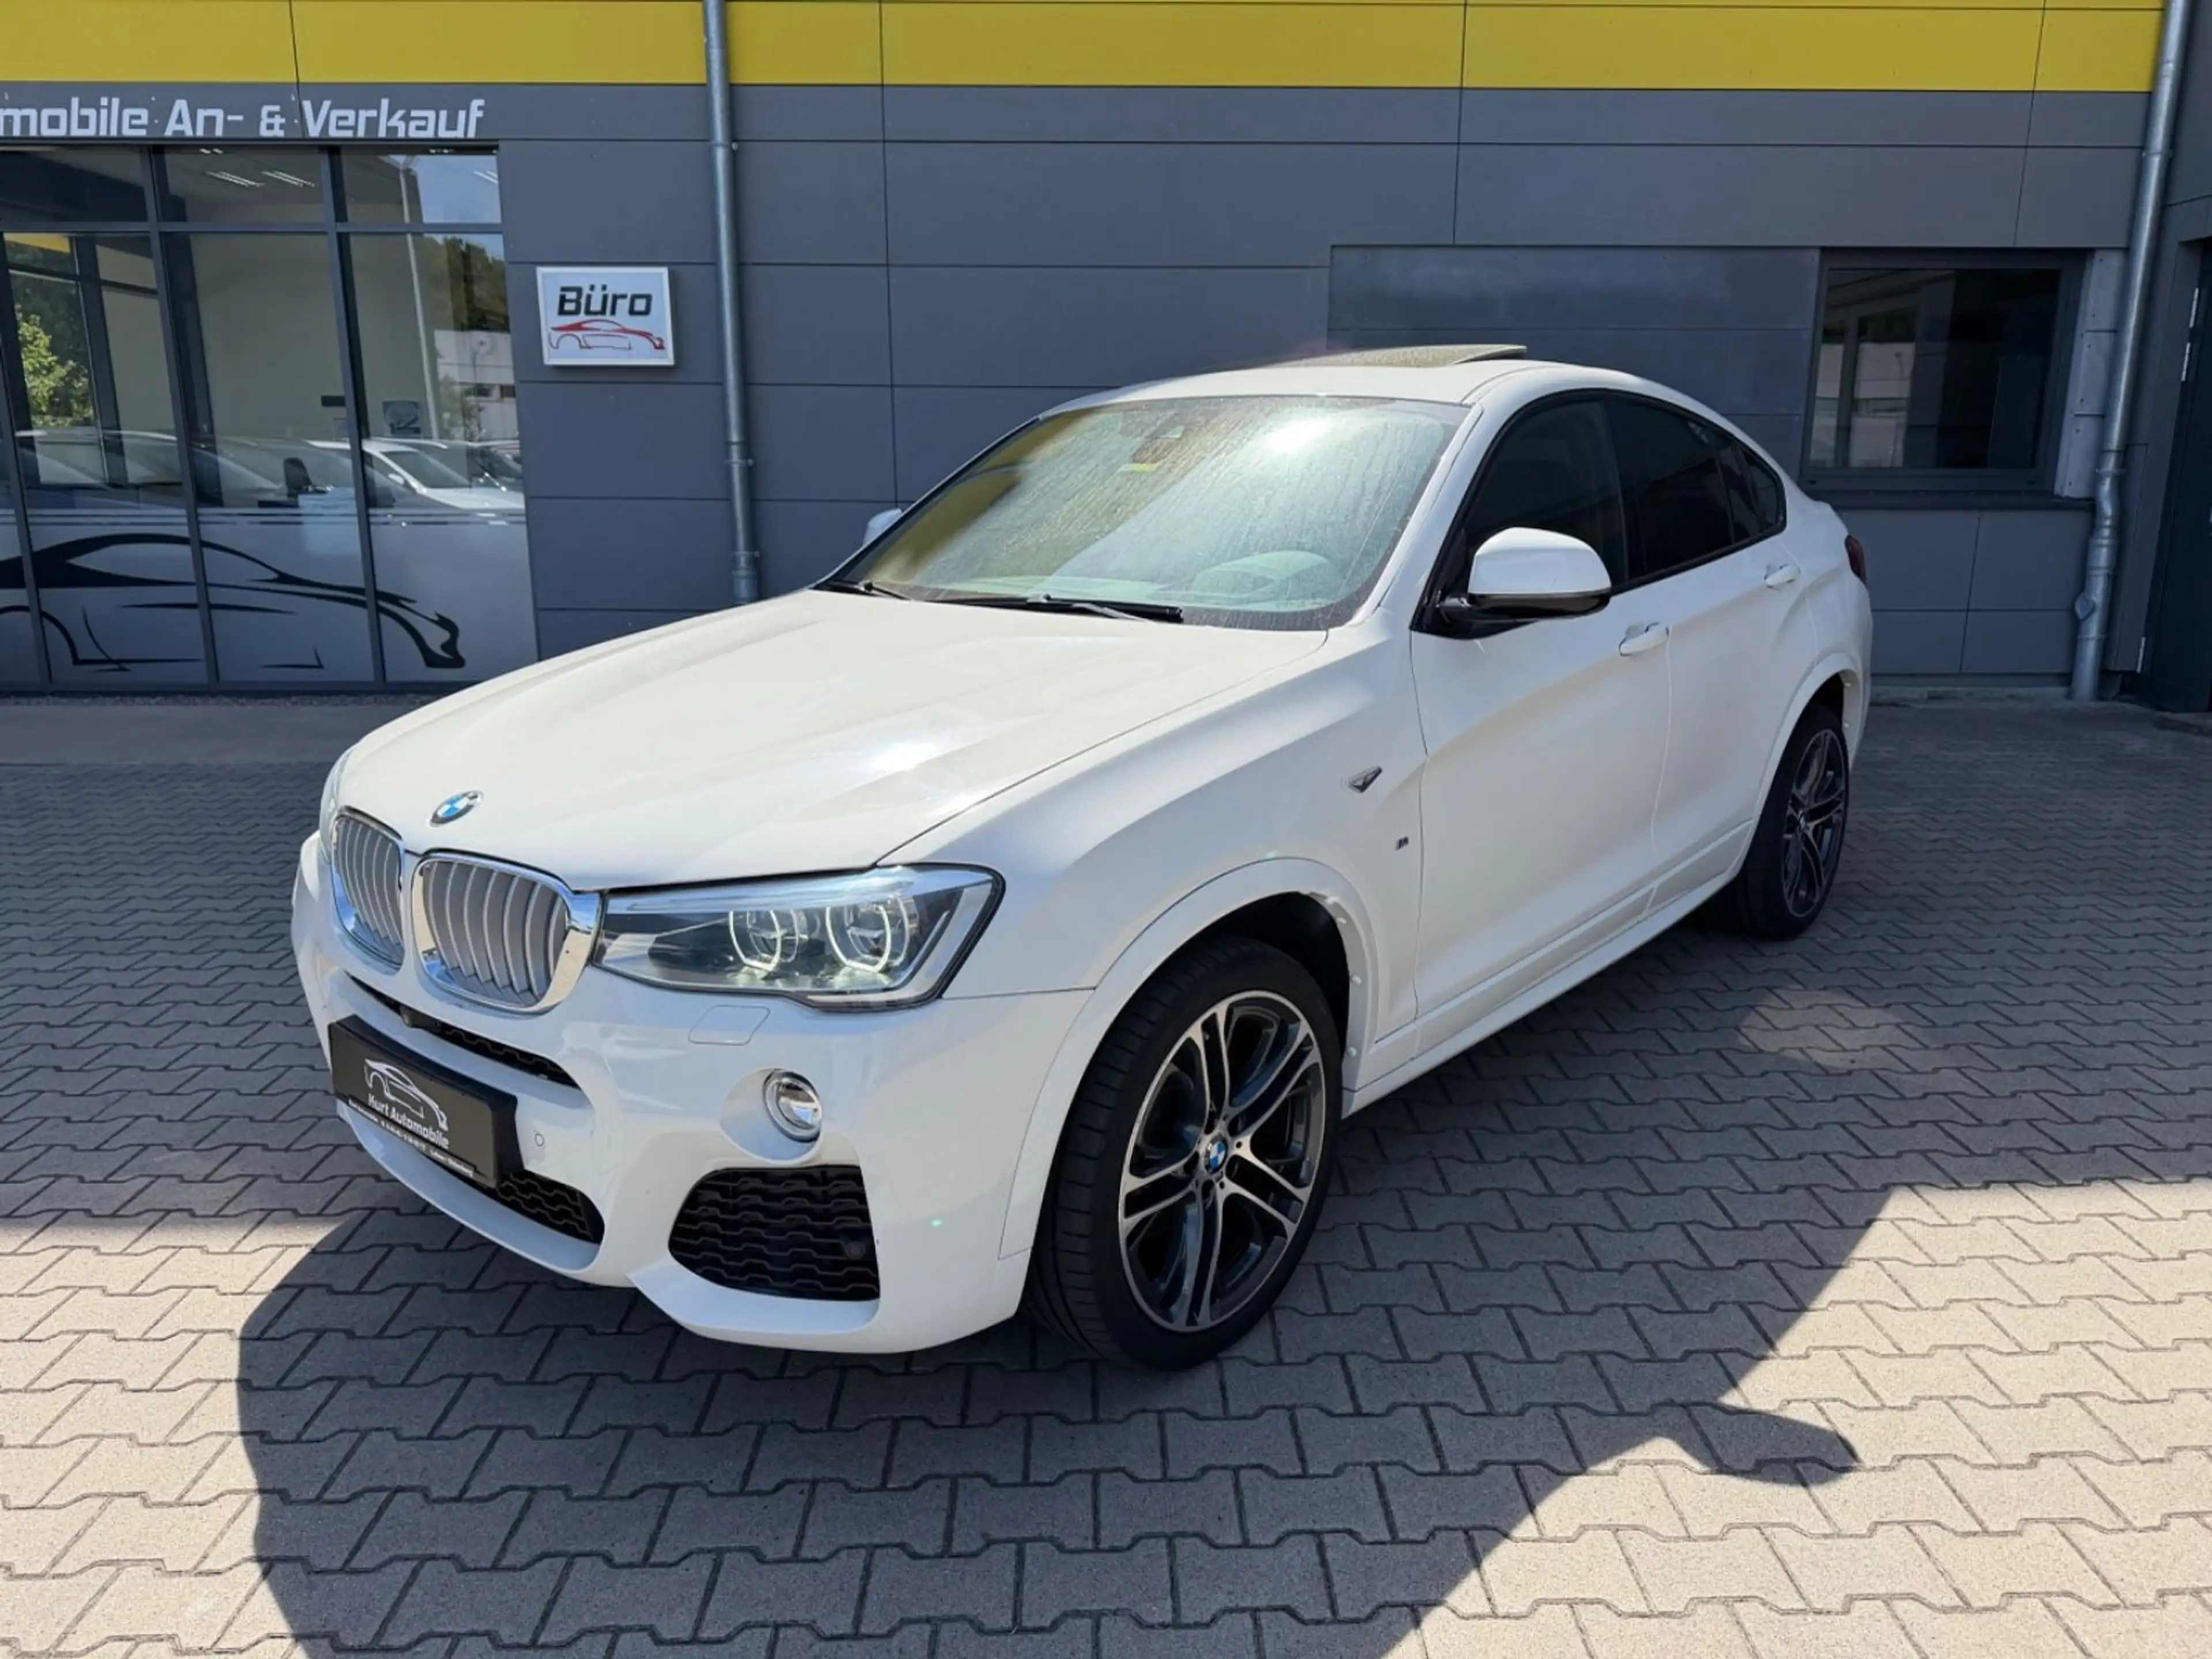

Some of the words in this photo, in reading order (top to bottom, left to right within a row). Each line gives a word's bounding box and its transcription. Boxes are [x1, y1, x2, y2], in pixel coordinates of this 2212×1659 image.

[0, 97, 148, 136] mobile
[164, 99, 244, 137] An-
[259, 105, 285, 137] &
[302, 98, 485, 138] Verkauf
[557, 284, 653, 316] Büro
[390, 1107, 449, 1150] Automobile
